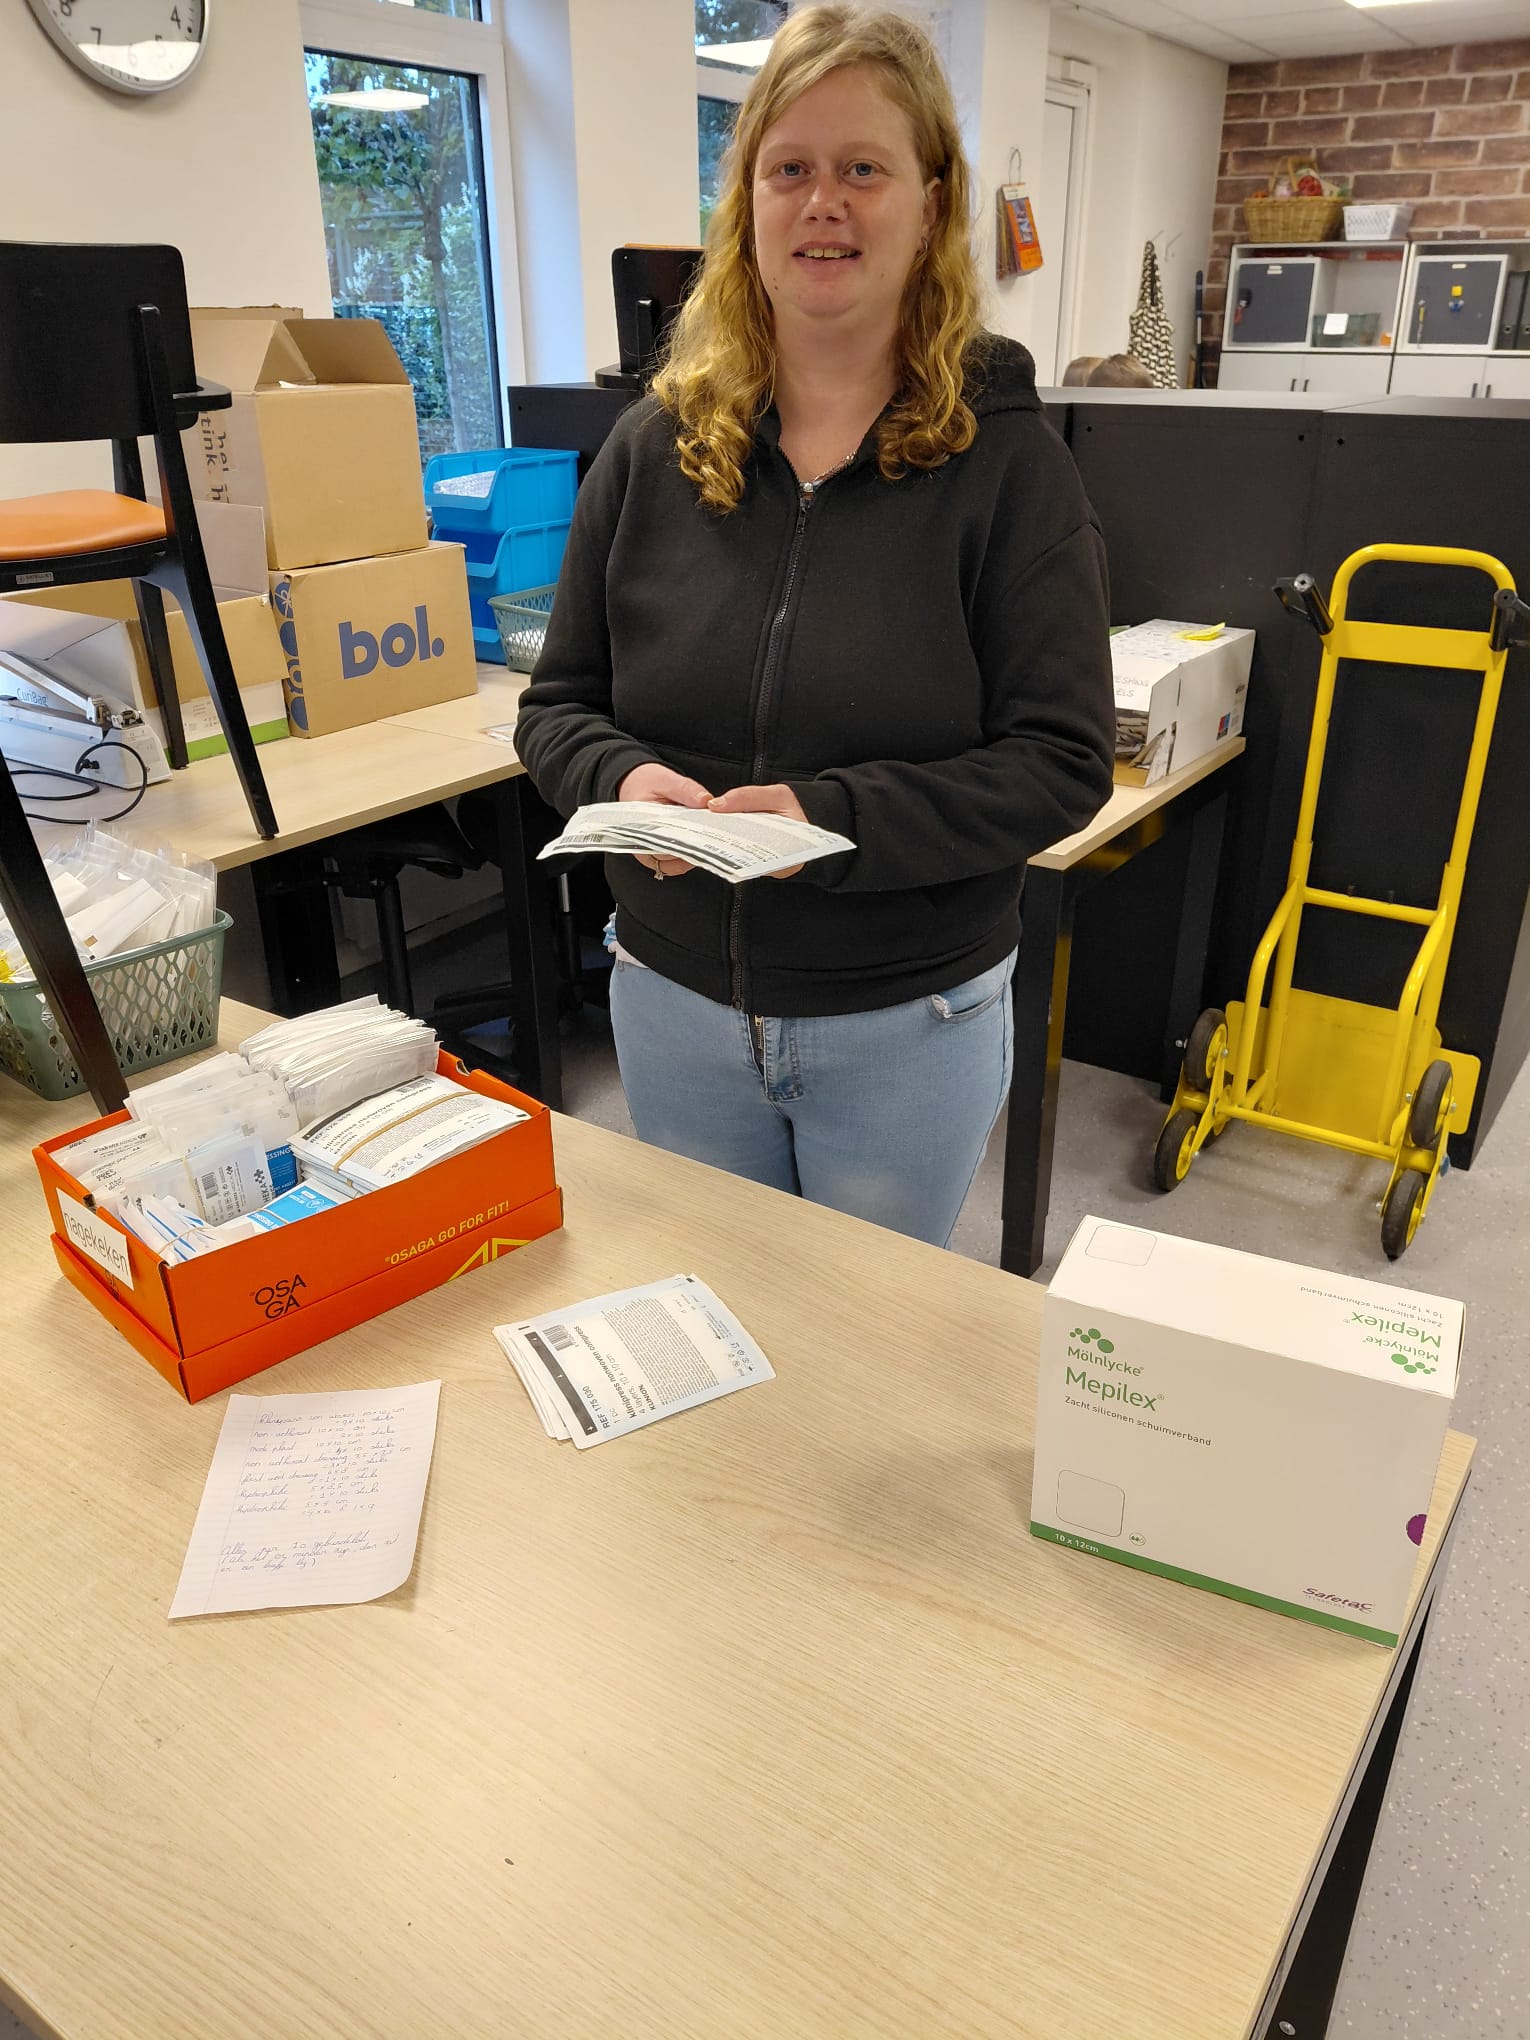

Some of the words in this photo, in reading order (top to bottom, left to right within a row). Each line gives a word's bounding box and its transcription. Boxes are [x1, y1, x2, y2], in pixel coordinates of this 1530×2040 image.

[170, 5, 181, 30] 4
[90, 27, 102, 46] 7
[338, 604, 445, 680] bol.
[438, 1226, 457, 1243] GO
[459, 1213, 484, 1233] FOR
[487, 1199, 509, 1233] FIT!
[64, 1212, 130, 1277] nagekeken
[1300, 1286, 1371, 1308] schuimverband
[1372, 1303, 1415, 1320] siliconen
[592, 1350, 617, 1383] nonwoven
[582, 1385, 595, 1400] 030
[612, 1382, 638, 1419] klinipress
[590, 1398, 602, 1412] 175
[597, 1413, 611, 1429] REF
[1064, 1395, 1091, 1411] Zacht
[1092, 1404, 1135, 1424] siliconen
[1136, 1419, 1212, 1446] schuimverband
[1055, 1533, 1066, 1542] 10
[1075, 1540, 1100, 1553] 12cm
